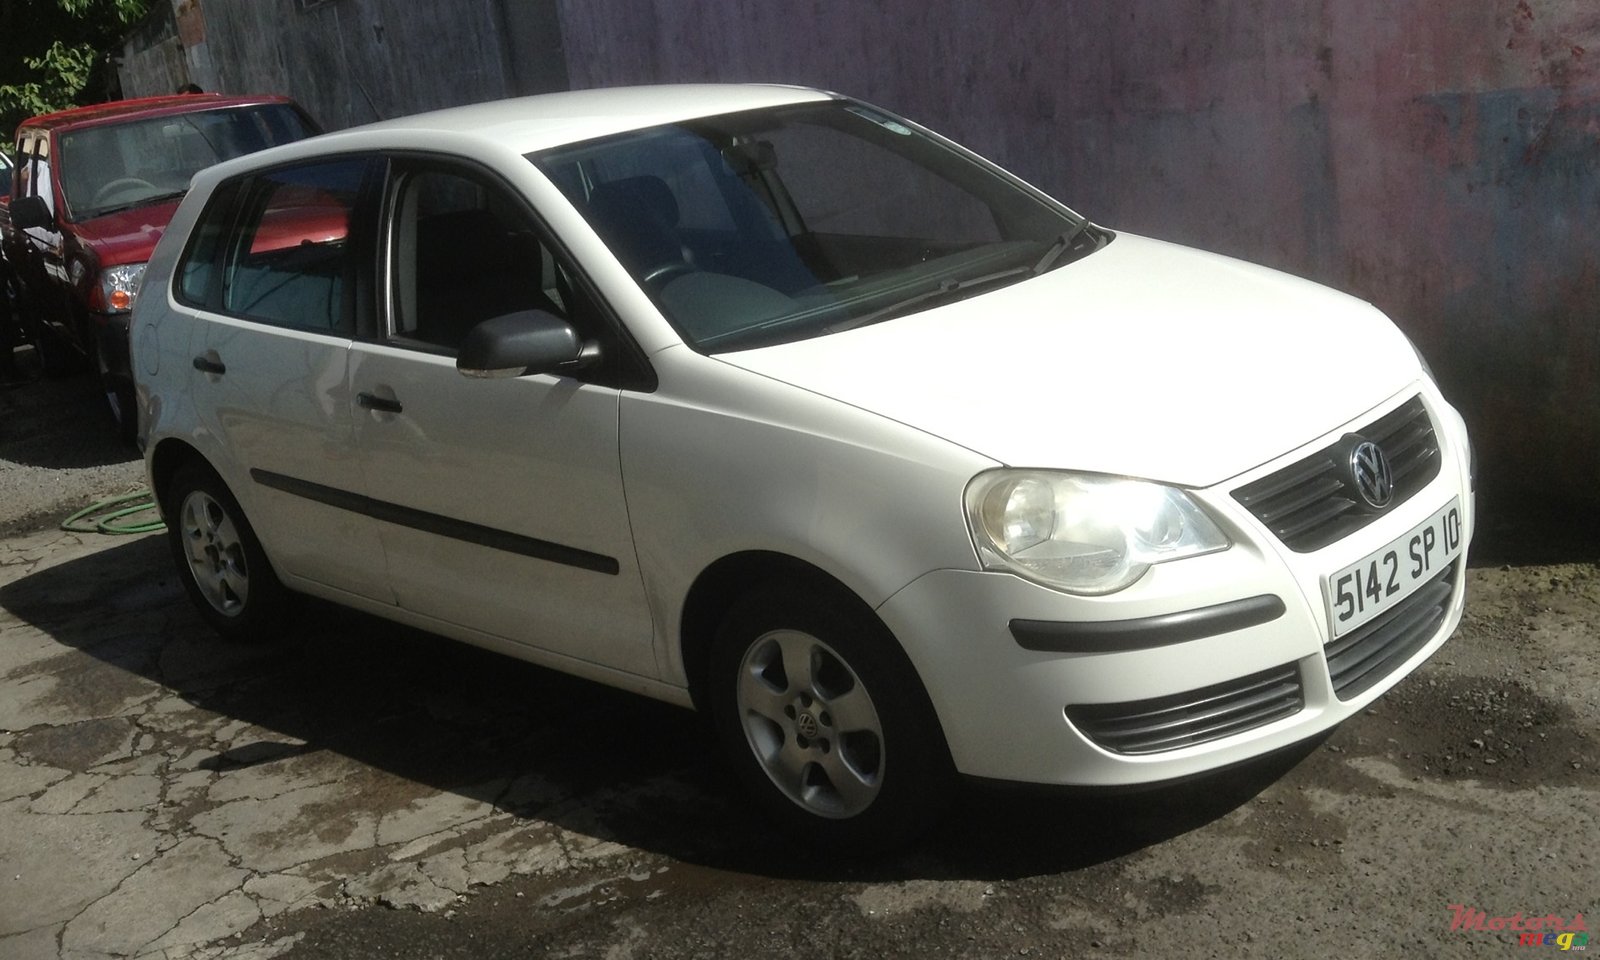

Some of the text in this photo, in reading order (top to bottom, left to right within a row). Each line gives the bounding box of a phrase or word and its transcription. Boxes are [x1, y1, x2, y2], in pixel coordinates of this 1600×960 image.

[1335, 507, 1460, 622] 5142 SP 10
